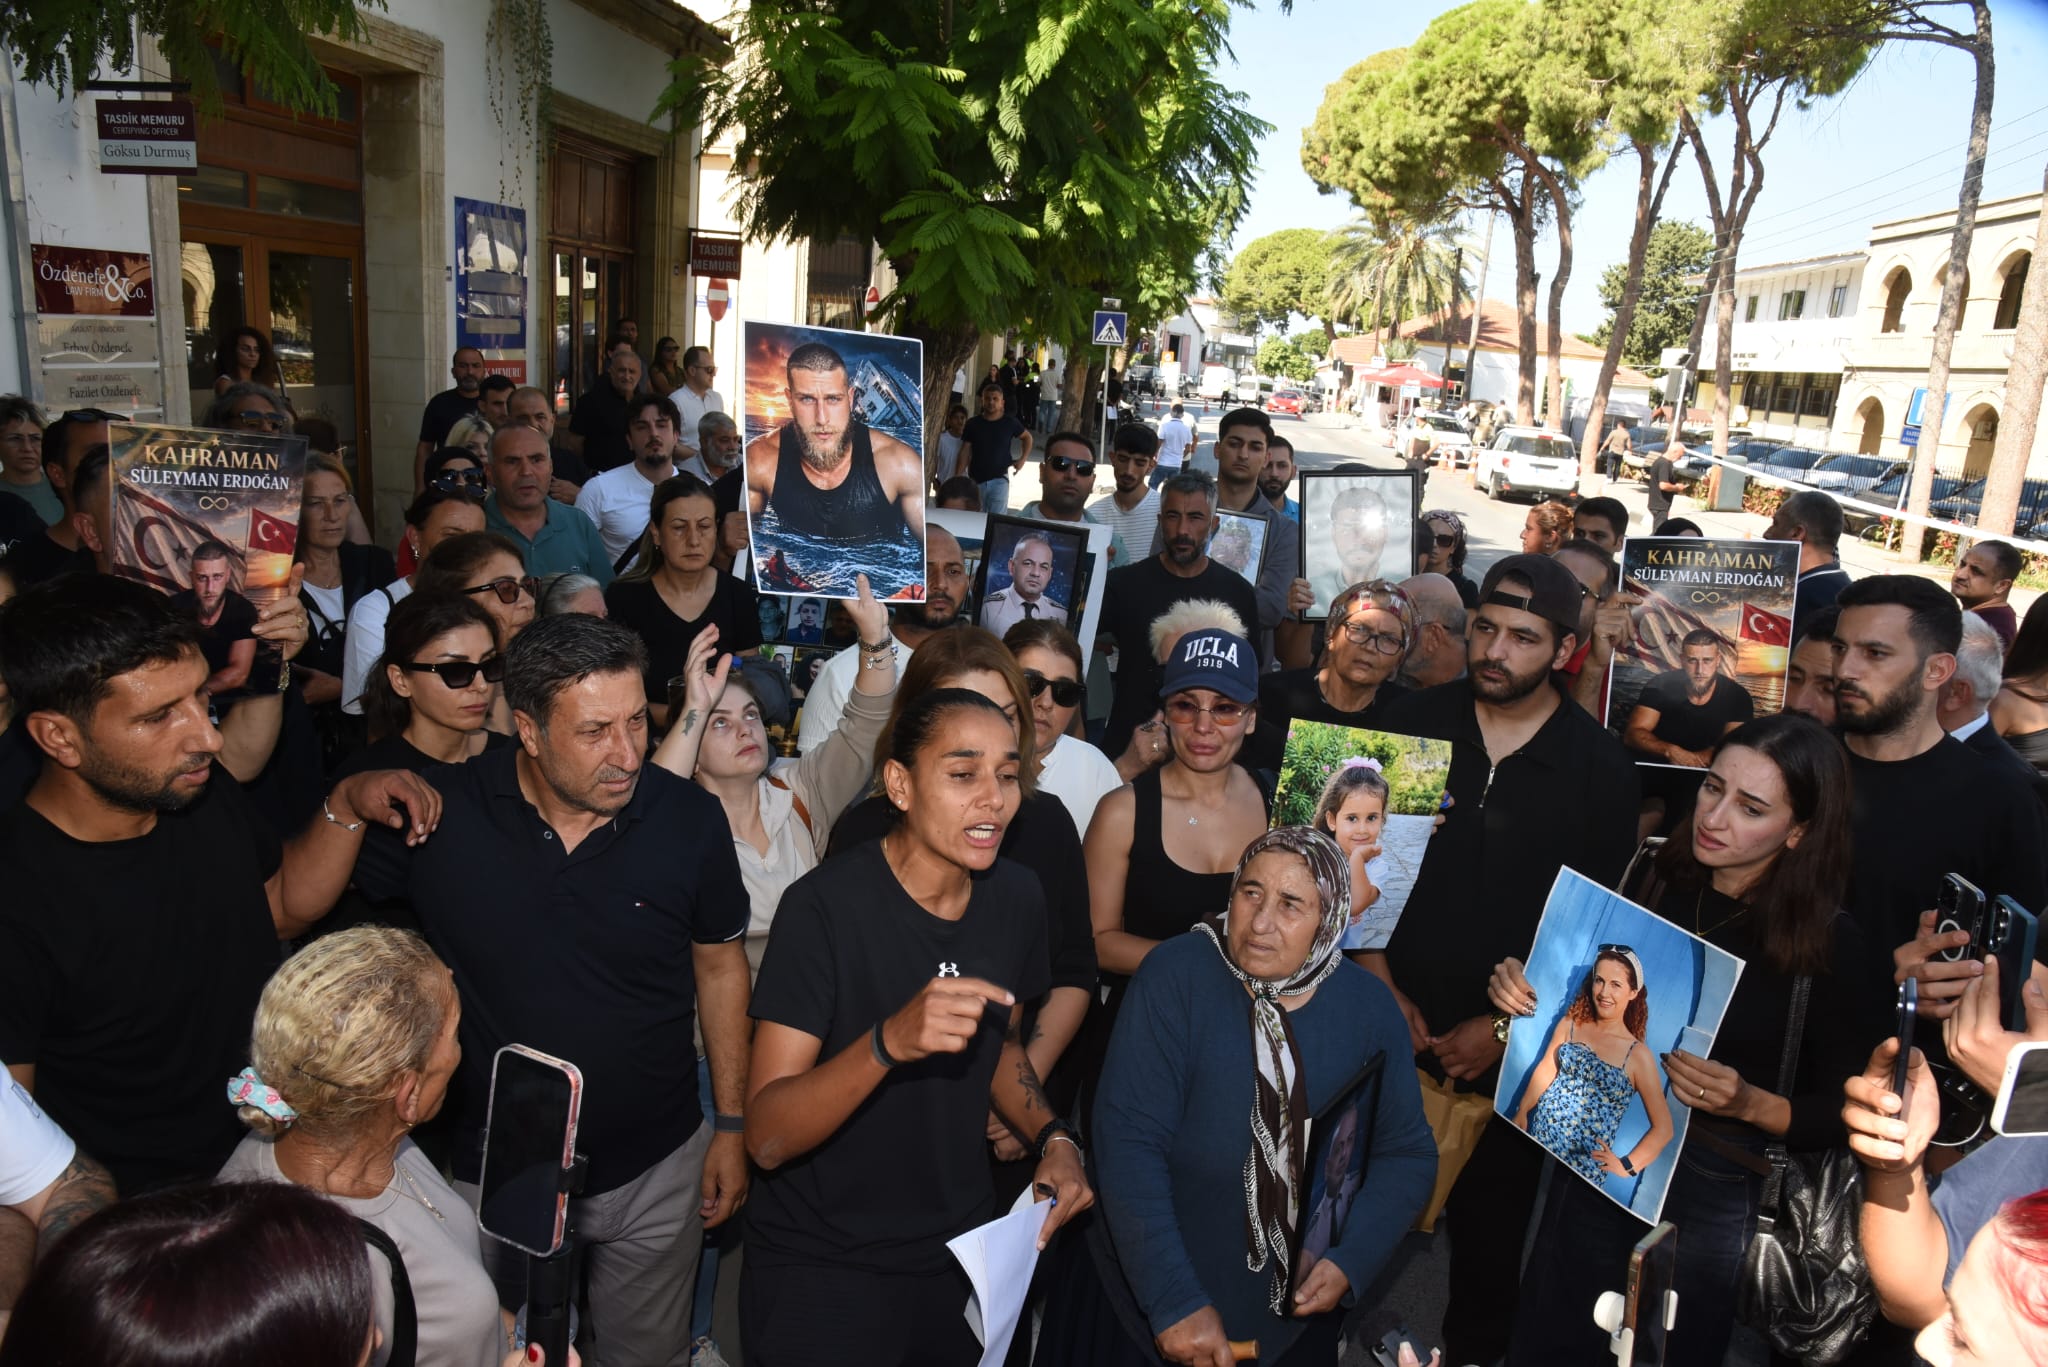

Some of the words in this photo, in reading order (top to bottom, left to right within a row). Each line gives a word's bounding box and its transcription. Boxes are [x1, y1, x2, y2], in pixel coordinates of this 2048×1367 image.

[104, 112, 138, 125] TASDİK
[141, 115, 185, 126] MEMURU
[112, 126, 151, 135] CERTIFYING
[151, 127, 179, 136] OFFICER
[103, 144, 141, 158] Göksu
[143, 144, 191, 161] Durmuş
[699, 243, 735, 257] TASDİK
[40, 260, 106, 285] Özdenefe
[692, 259, 739, 272] MEMURU
[65, 285, 83, 296] LAW
[84, 286, 104, 297] FIRM
[144, 444, 280, 471] KAHRAMAN
[130, 466, 219, 487] SÜLEYMAN
[223, 473, 290, 490] ERDOĞAN
[1647, 549, 1774, 570] KAHRAMAN
[1633, 566, 1711, 584] SÜLEYMAN
[1715, 571, 1784, 588] ERDOĞAN
[1184, 636, 1239, 668] UCLA
[1197, 657, 1223, 669] 1919
